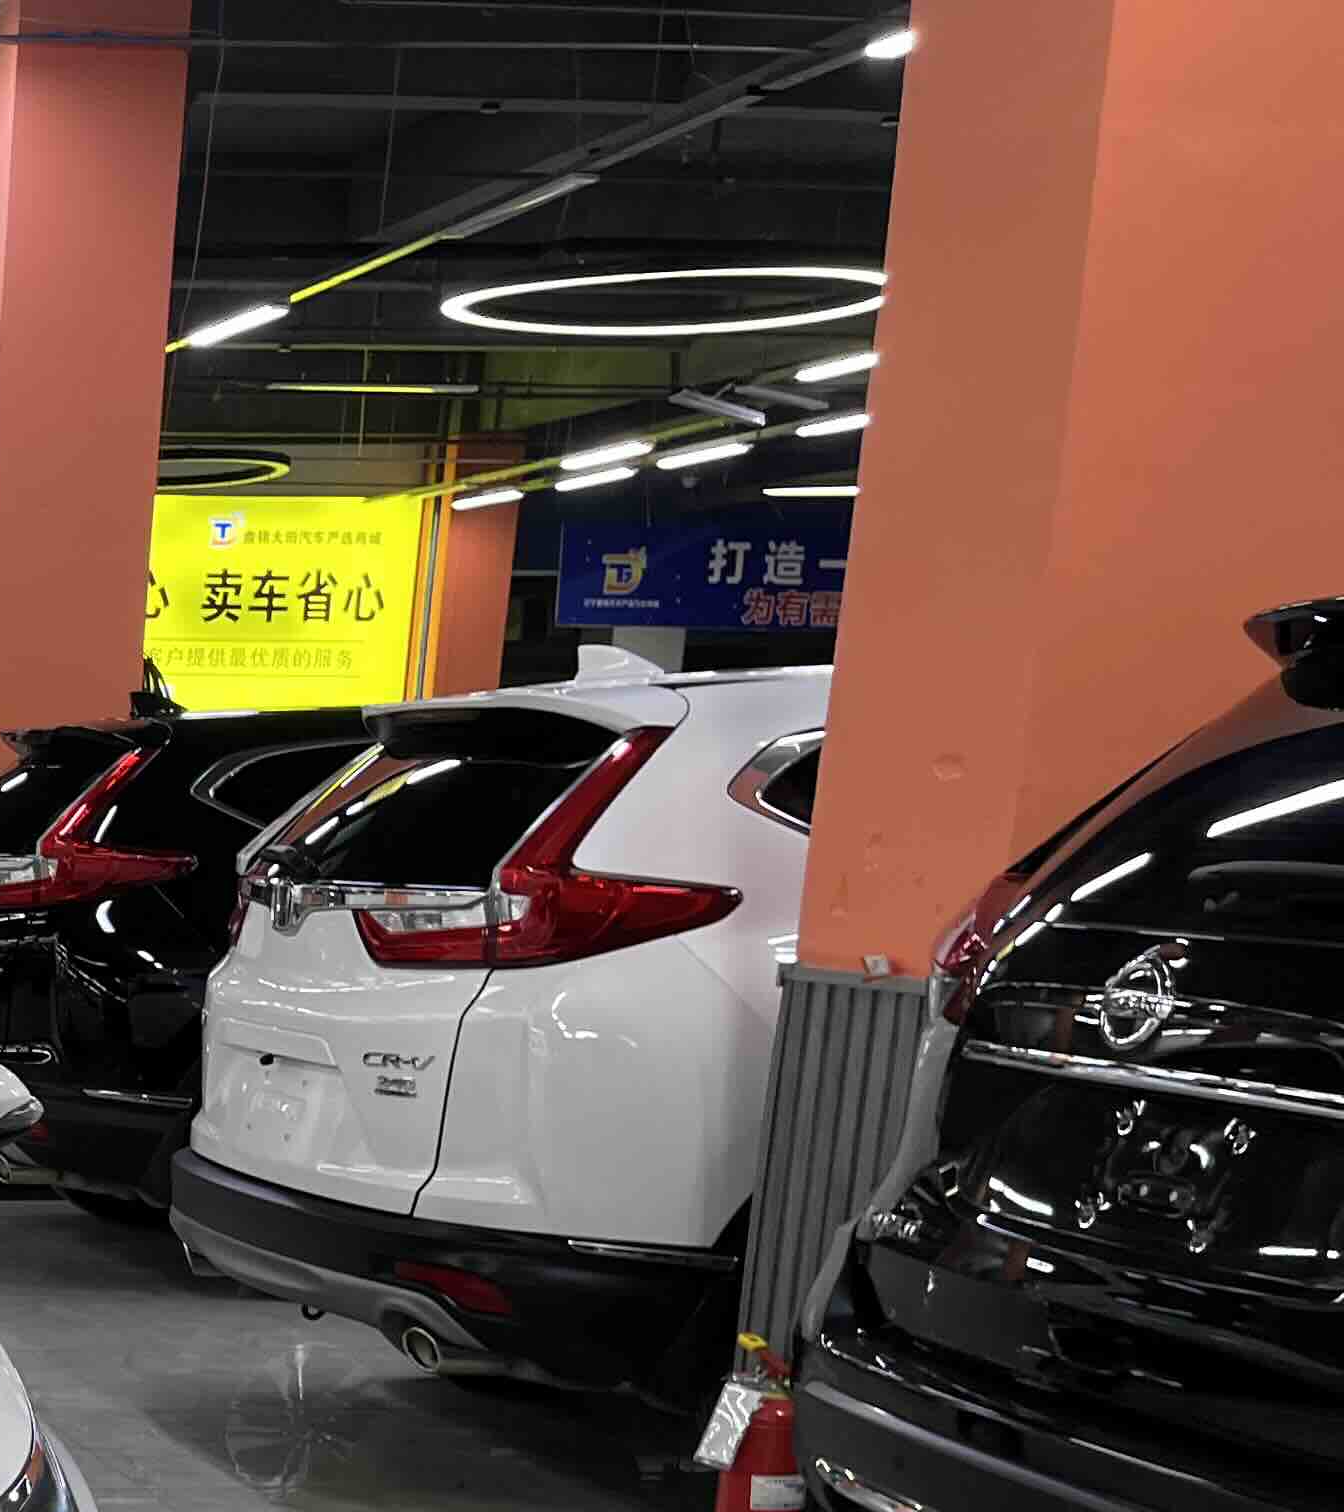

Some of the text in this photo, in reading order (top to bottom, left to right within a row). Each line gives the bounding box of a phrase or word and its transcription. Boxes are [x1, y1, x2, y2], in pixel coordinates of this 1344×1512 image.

[708, 538, 848, 584] 打造一
[201, 569, 385, 623] 卖车省心
[363, 1052, 435, 1071] CR-V
